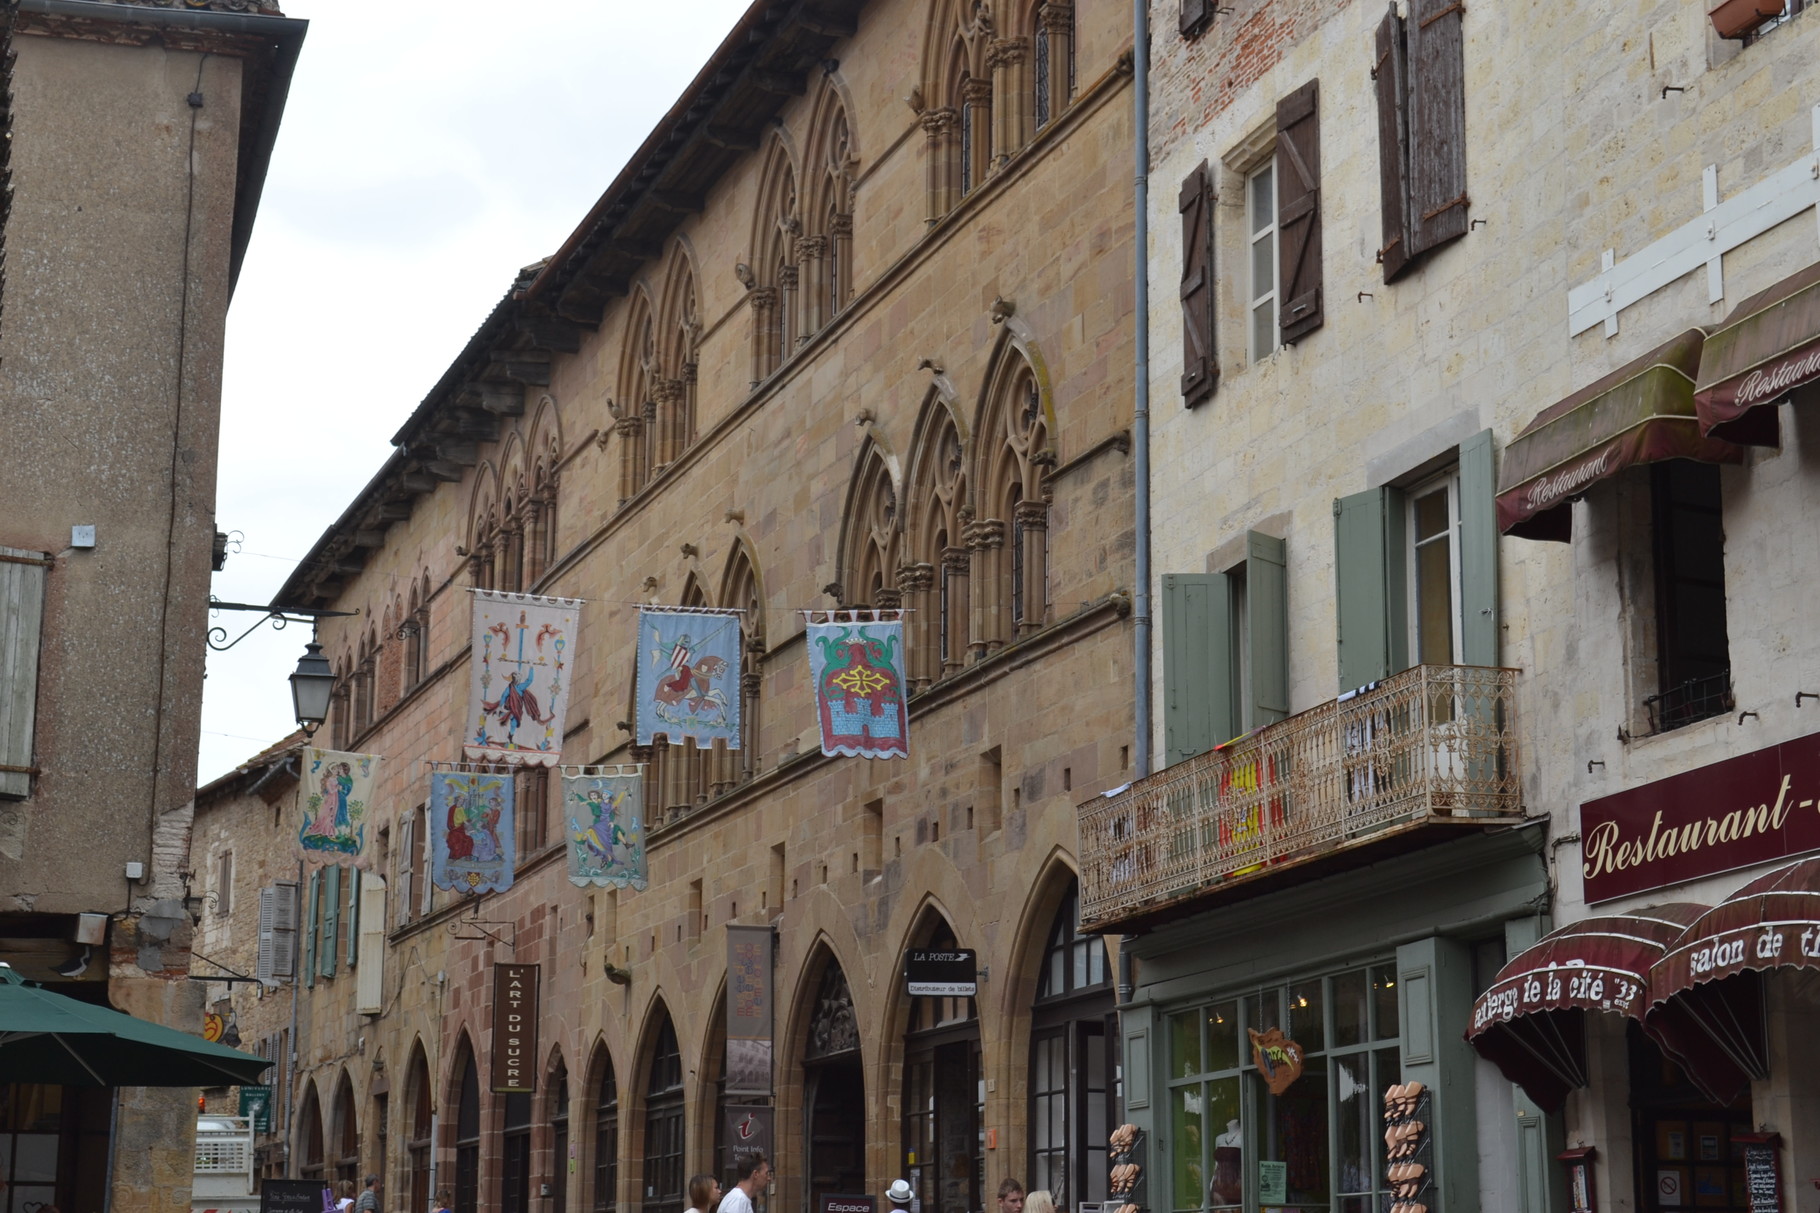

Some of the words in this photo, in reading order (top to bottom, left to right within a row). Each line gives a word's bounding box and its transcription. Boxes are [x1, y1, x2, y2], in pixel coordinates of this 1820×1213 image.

[1526, 446, 1612, 510] Restaurant
[1583, 774, 1794, 879] Restaurant
[913, 953, 926, 961] LA
[929, 953, 955, 961] POSTE
[1690, 936, 1744, 976] salon
[1756, 926, 1783, 958] de
[509, 969, 524, 1008] L'ART
[1545, 972, 1561, 1000] la
[1569, 970, 1604, 1001] cité
[508, 1014, 521, 1032] DU
[507, 1038, 520, 1087] SUCRE
[750, 1145, 764, 1153] Info
[827, 1202, 870, 1213] Espace
